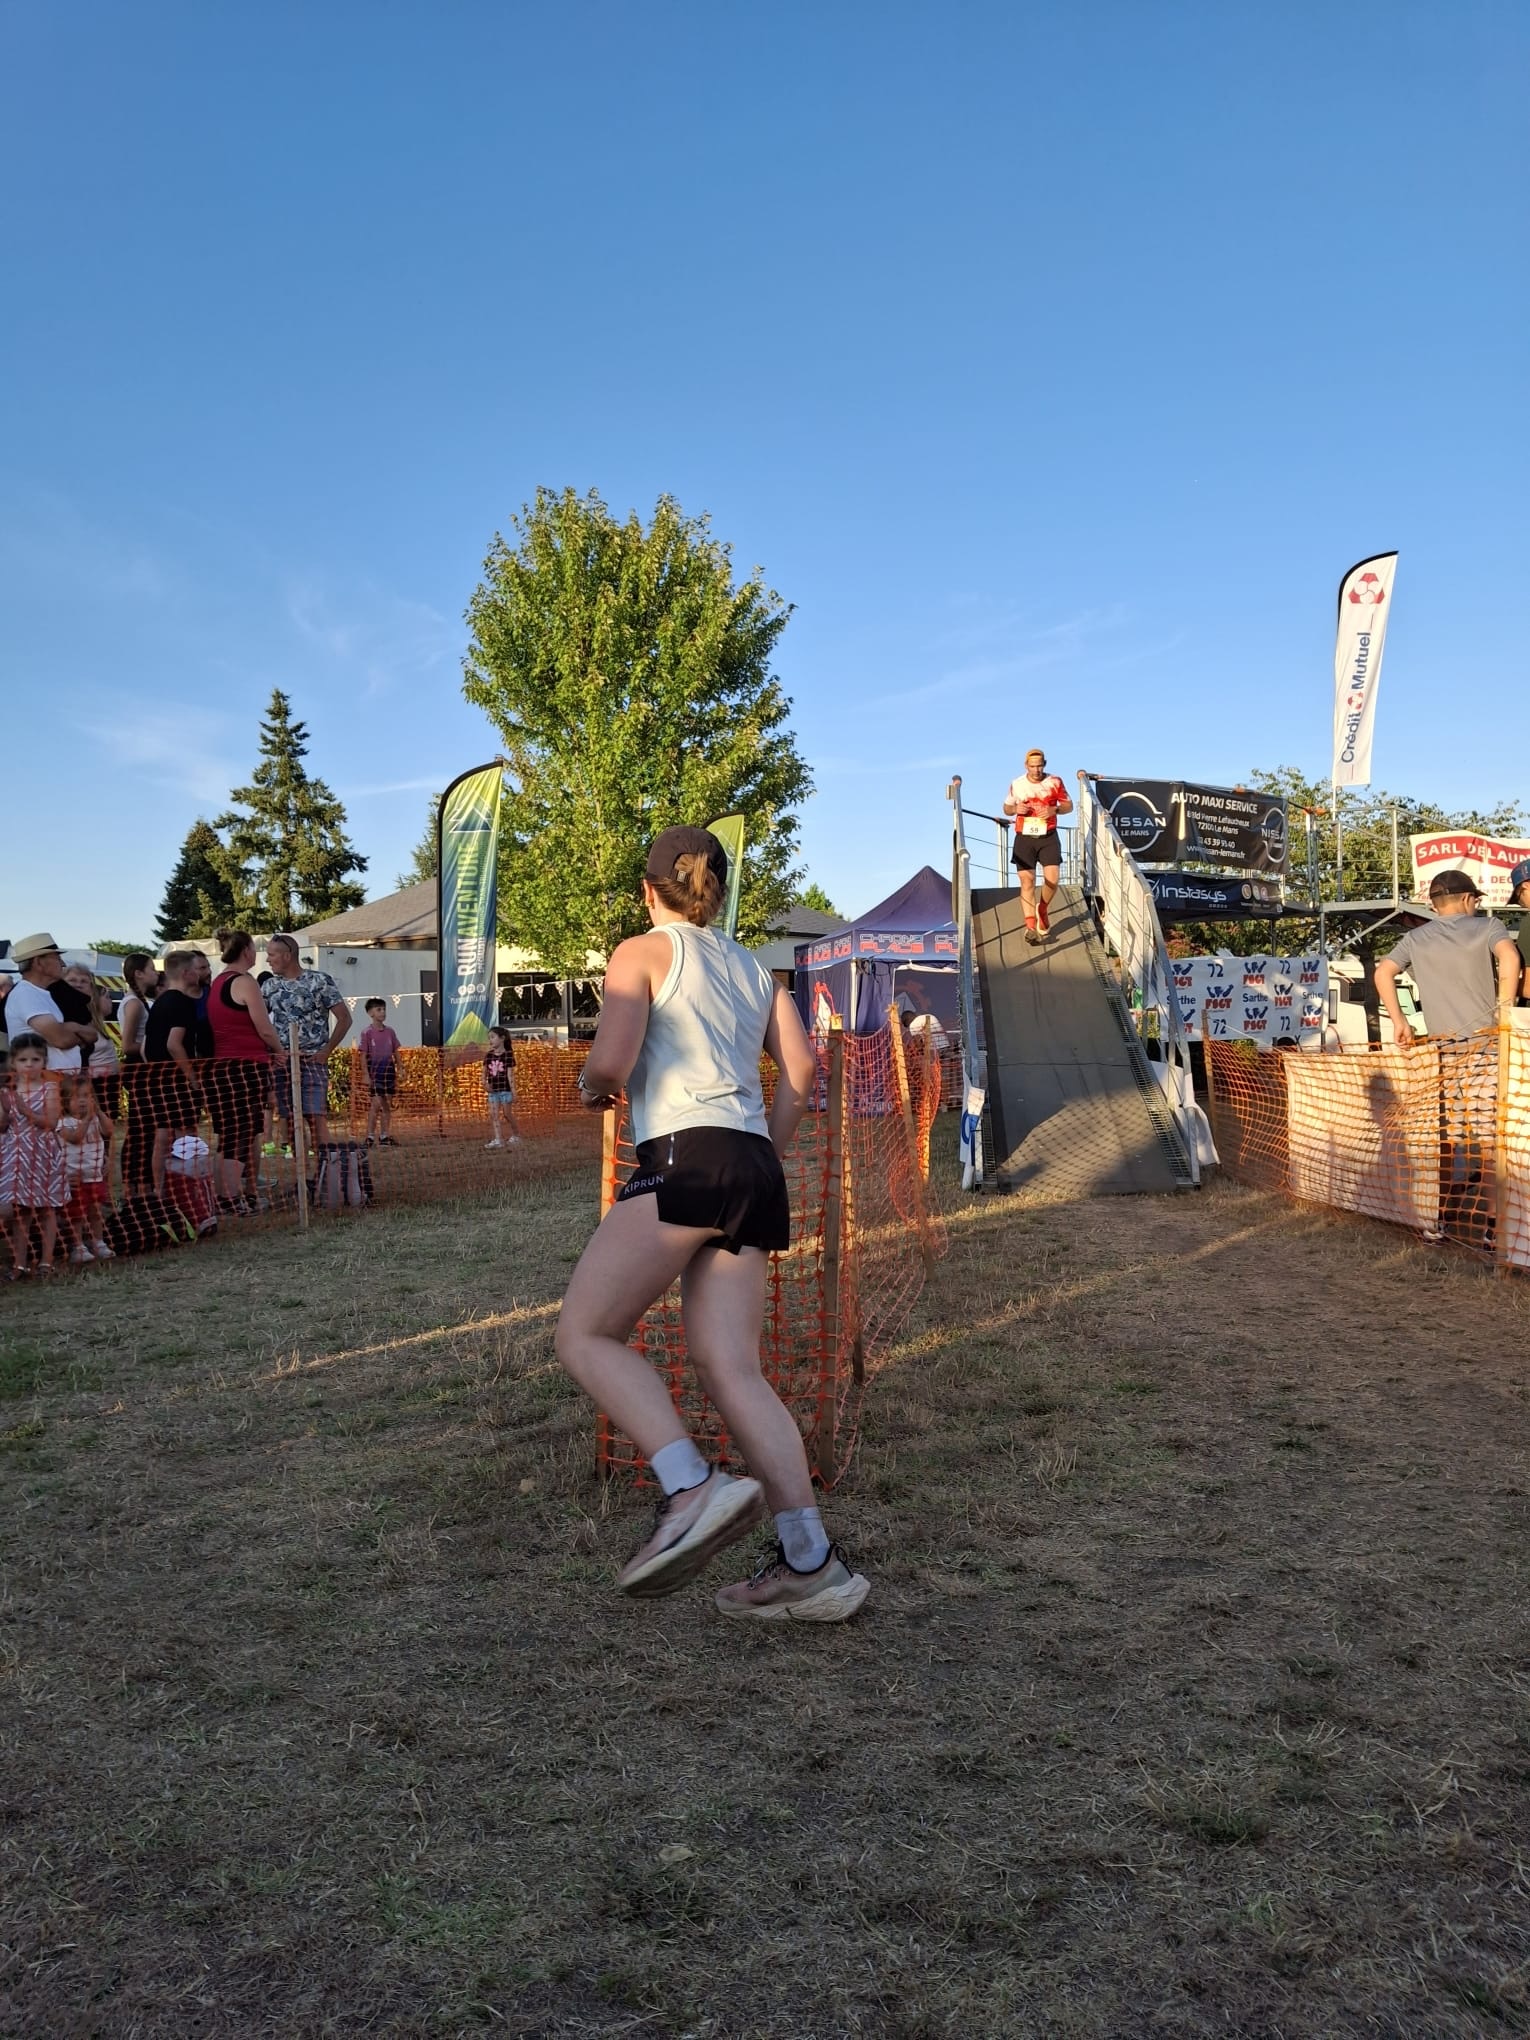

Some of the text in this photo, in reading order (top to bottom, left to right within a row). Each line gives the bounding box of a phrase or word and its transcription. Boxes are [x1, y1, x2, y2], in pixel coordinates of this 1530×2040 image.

[1341, 632, 1372, 763] Crédit Mutuel
[1171, 792, 1258, 815] AUTO MAXI SERVICE
[1109, 816, 1167, 827] ISSAN
[1261, 827, 1285, 841] NISSA
[1418, 843, 1462, 859] SARL
[1161, 884, 1227, 903] Instasys
[457, 843, 479, 976] RUNAVENTURE
[1207, 963, 1224, 978] 72
[1279, 960, 1290, 974] 72
[1166, 994, 1197, 1005] Sthe
[1205, 998, 1232, 1009] FSGT
[1242, 993, 1268, 1003] Sarthe
[1213, 1018, 1227, 1035] 72
[1280, 1016, 1291, 1031] 72
[624, 1175, 665, 1195] KIPRUN
